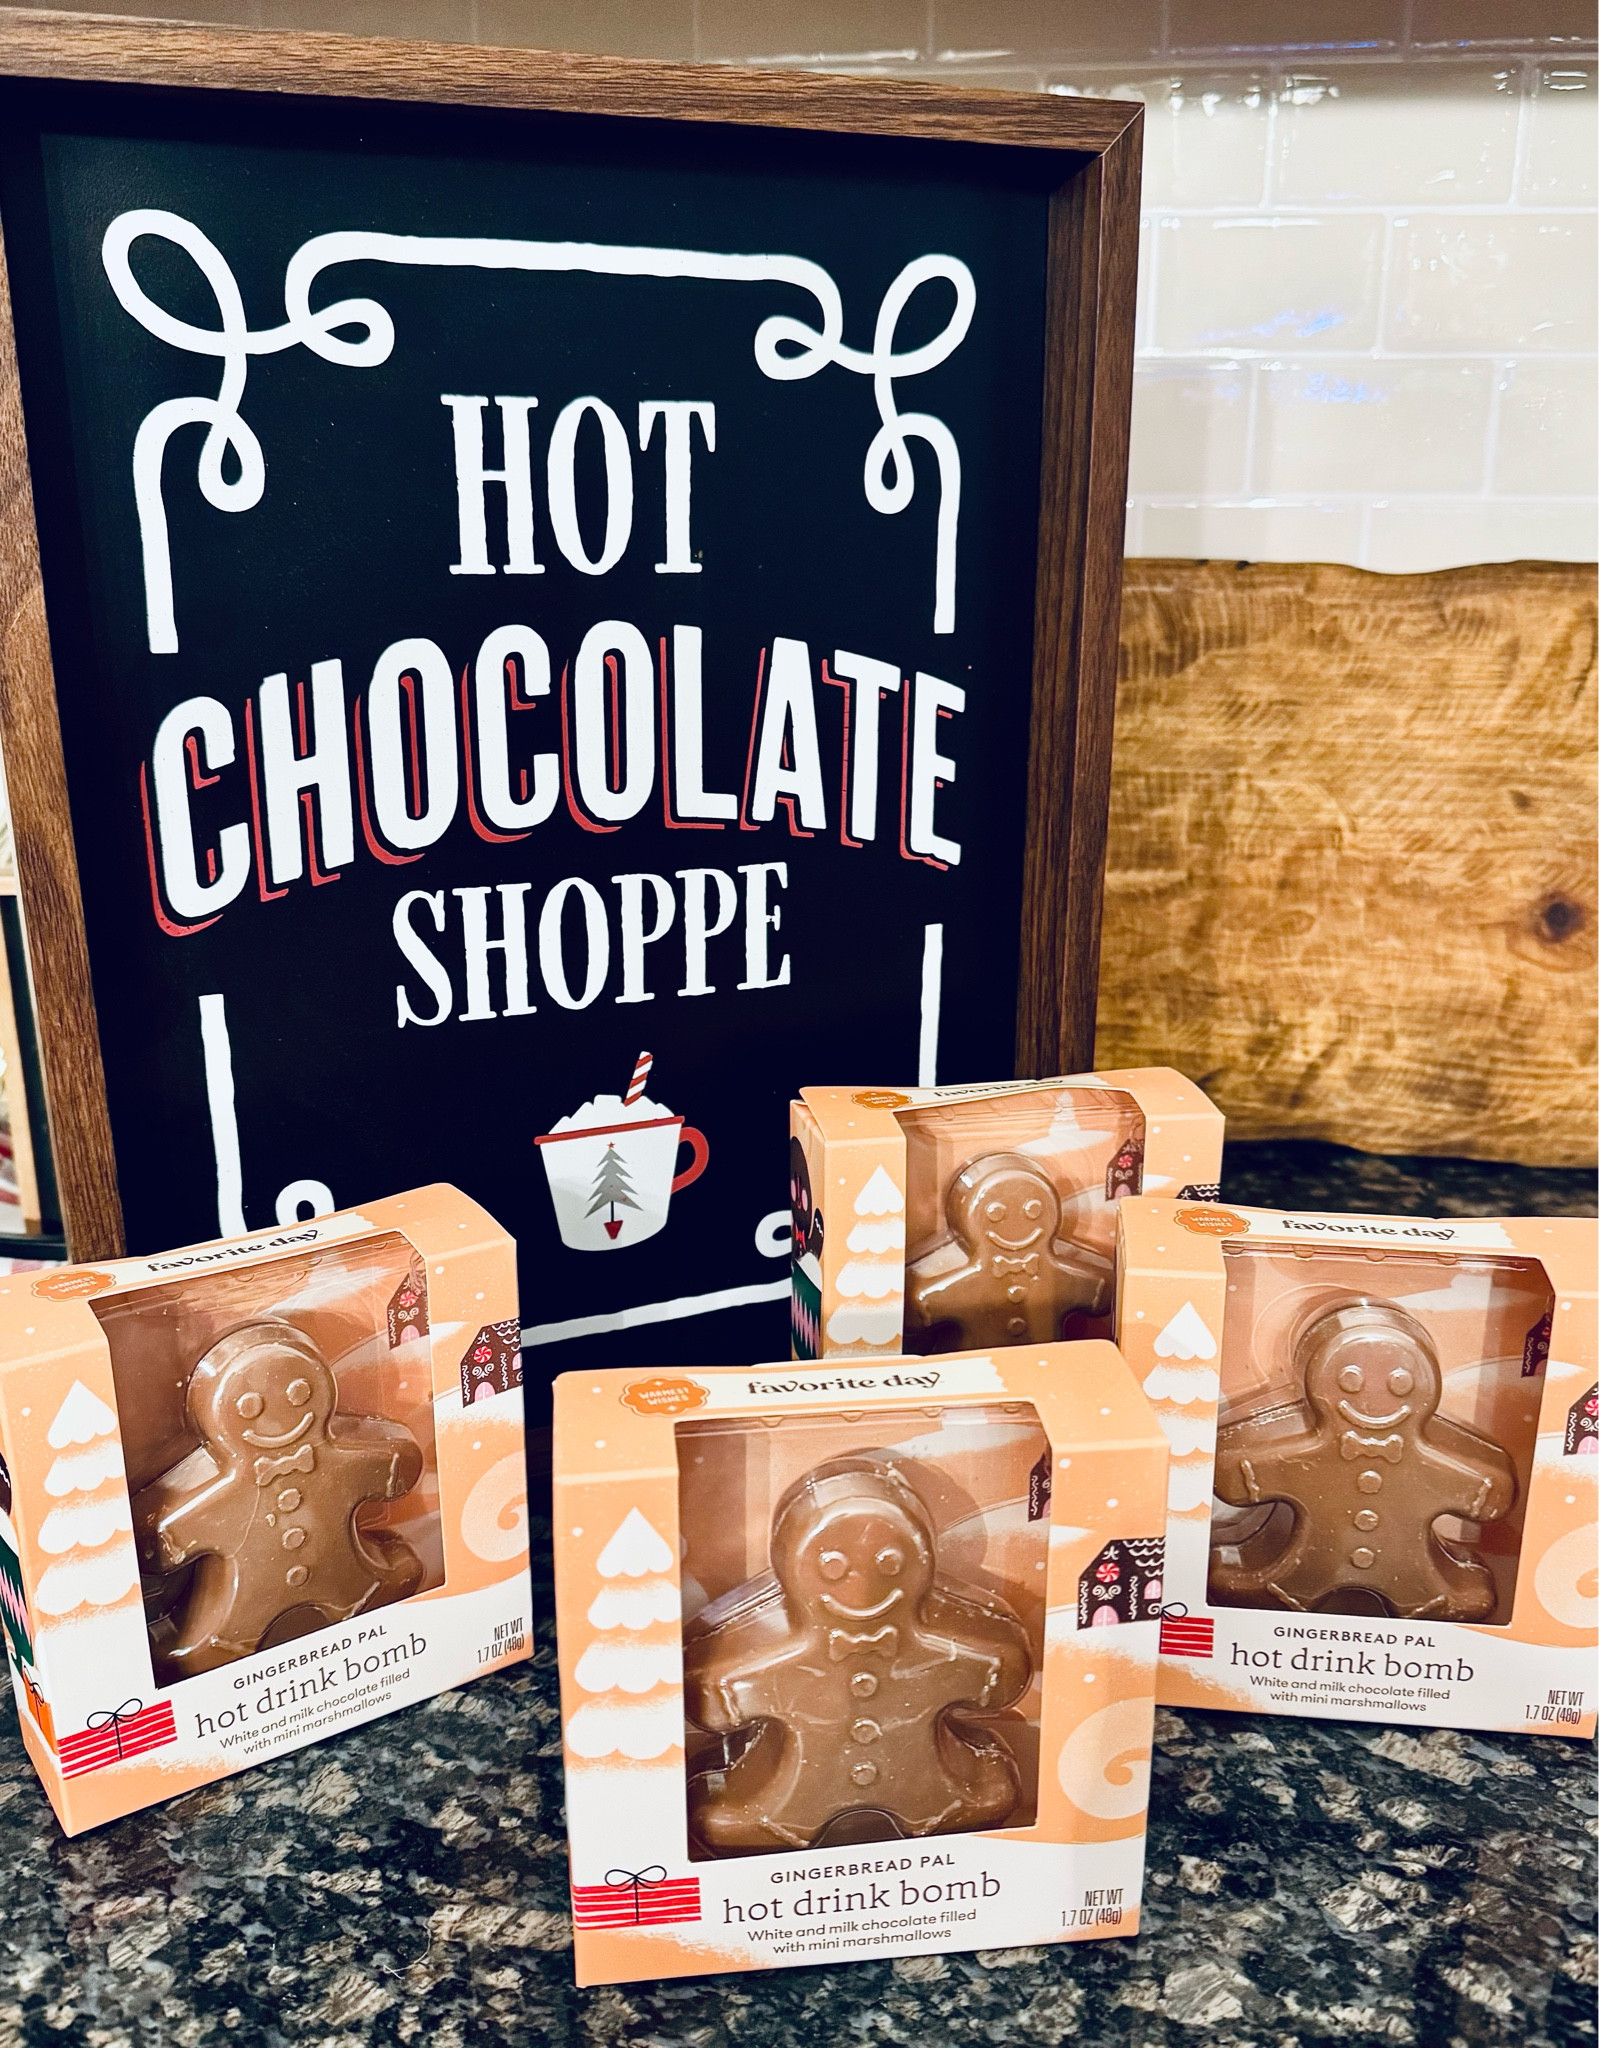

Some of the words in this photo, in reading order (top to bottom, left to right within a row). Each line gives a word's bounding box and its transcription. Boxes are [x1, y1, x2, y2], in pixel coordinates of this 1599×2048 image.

[441, 394, 716, 575] HOT
[140, 620, 968, 938] CHOCOLATE
[392, 862, 790, 1029] SHOPPE
[1282, 1220, 1396, 1236] favorite
[1402, 1228, 1455, 1241] day
[147, 1242, 265, 1272] favorite
[269, 1229, 319, 1248] day
[638, 1386, 690, 1400] WARMEST
[749, 1377, 877, 1394] favorite
[883, 1372, 941, 1388] day
[646, 1394, 690, 1406] WISHES
[494, 1622, 509, 1641] NET
[510, 1616, 523, 1635] WT
[1273, 1626, 1397, 1645] GINGERBREAD
[1404, 1635, 1436, 1648] PAL
[233, 1638, 352, 1690] GINGERBREAD
[358, 1624, 388, 1644] PAL
[477, 1646, 490, 1664] 1.7
[491, 1641, 503, 1658] OZ
[504, 1633, 525, 1655] (48g)
[1230, 1642, 1283, 1669] hot
[1291, 1647, 1376, 1676] drink
[1384, 1653, 1475, 1682] bomb
[194, 1701, 249, 1739] hot
[256, 1666, 338, 1715] drink
[343, 1632, 427, 1682] bomb
[1249, 1675, 1289, 1688] White
[1291, 1679, 1317, 1691] and
[1319, 1680, 1346, 1693] milk
[1348, 1682, 1415, 1698] chocolate
[1417, 1687, 1451, 1700] filled
[1547, 1690, 1567, 1705] NET
[1568, 1691, 1584, 1706] WT
[219, 1731, 259, 1750] White
[261, 1716, 287, 1734] and
[289, 1705, 315, 1727] milk
[317, 1683, 378, 1713] chocolate
[379, 1668, 411, 1689] filled
[1270, 1691, 1298, 1702] with
[1300, 1693, 1328, 1704] mini
[1330, 1695, 1427, 1712] marshmallows
[1525, 1704, 1540, 1720] 1.7
[1541, 1705, 1556, 1721] OZ
[1556, 1707, 1582, 1725] (48g)
[243, 1736, 271, 1755] with
[273, 1728, 301, 1747] mini
[302, 1691, 392, 1739] marshmallows
[770, 1858, 912, 1884] GINGERBREAD
[920, 1853, 956, 1869] PAL
[722, 1898, 784, 1924] hot
[793, 1883, 891, 1916] drink
[899, 1871, 1001, 1906] bomb
[1084, 1889, 1105, 1907] NET
[1106, 1888, 1124, 1905] WT
[747, 1928, 793, 1942] White
[795, 1924, 826, 1938] and
[829, 1921, 859, 1935] milk
[861, 1914, 937, 1932] chocolate
[939, 1908, 977, 1923] filled
[1061, 1909, 1077, 1927] 1.7
[1079, 1908, 1094, 1925] OZ
[1095, 1906, 1123, 1927] (48g)
[772, 1941, 805, 1954] with
[808, 1937, 840, 1951] mini
[842, 1928, 952, 1948] marshmallows
